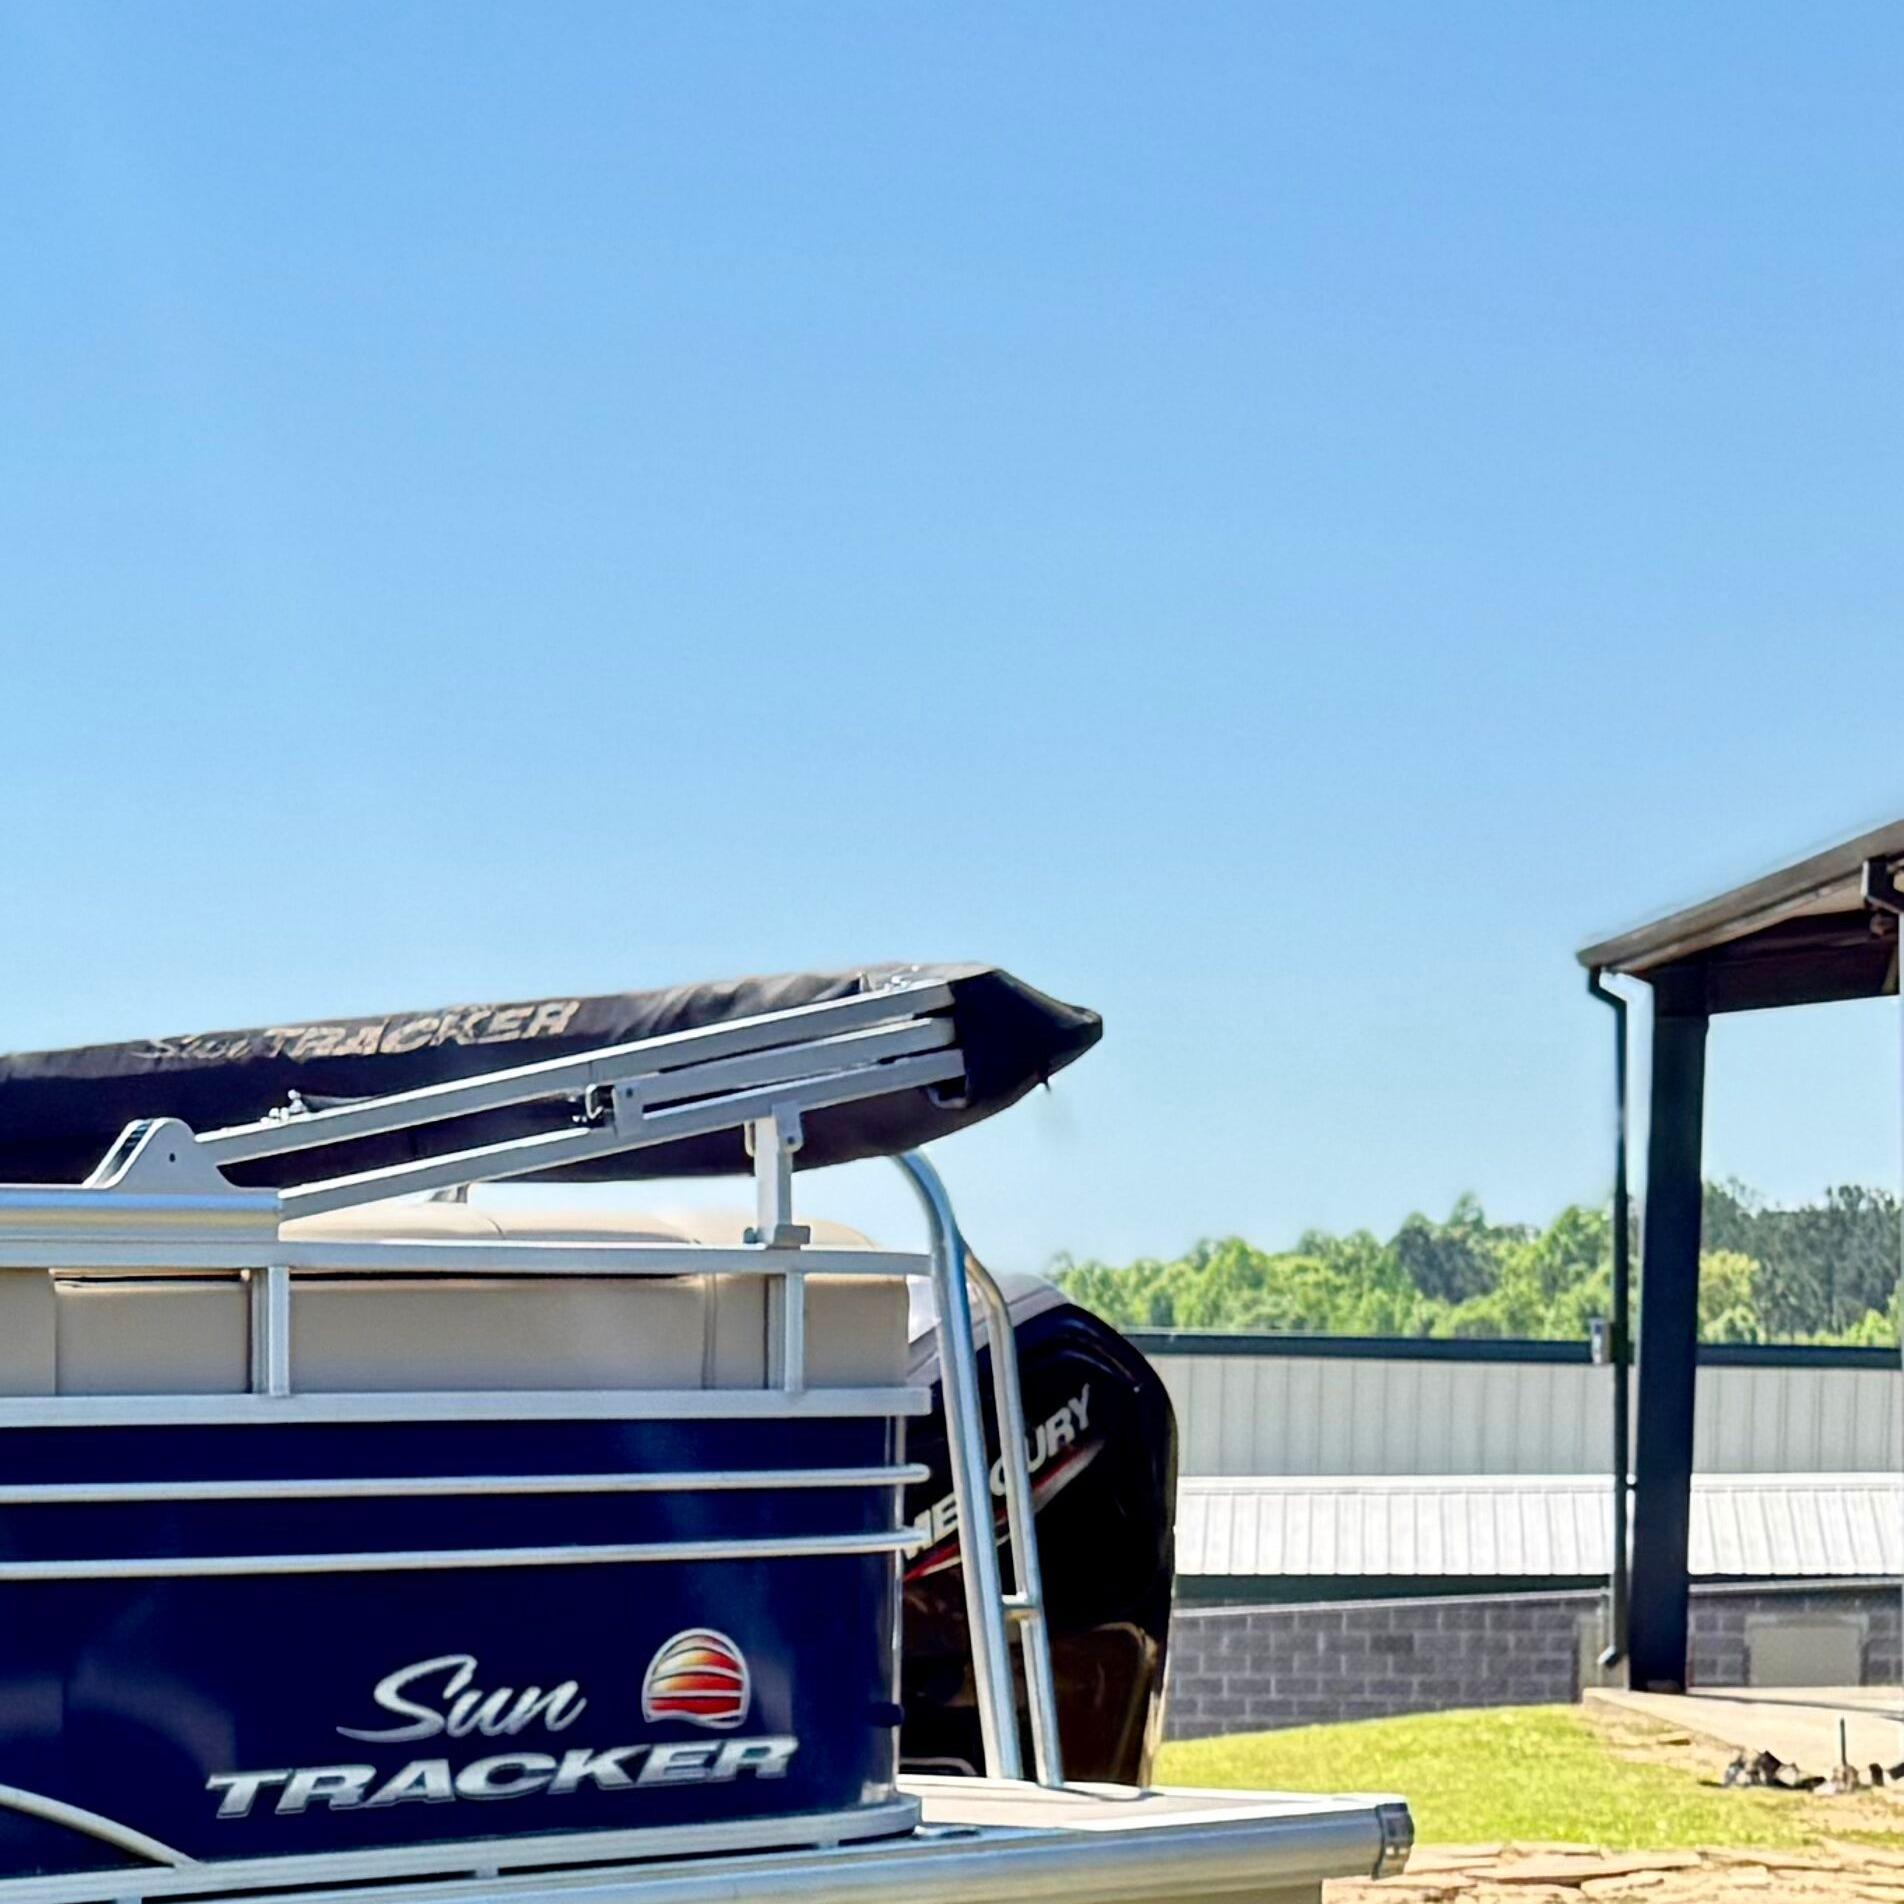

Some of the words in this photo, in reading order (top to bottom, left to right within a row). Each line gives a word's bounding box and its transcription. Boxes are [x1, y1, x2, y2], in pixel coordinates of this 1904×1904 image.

[264, 1001, 579, 1060] TRACKER
[336, 1654, 586, 1742] Sun
[206, 1735, 799, 1819] TRACKER
